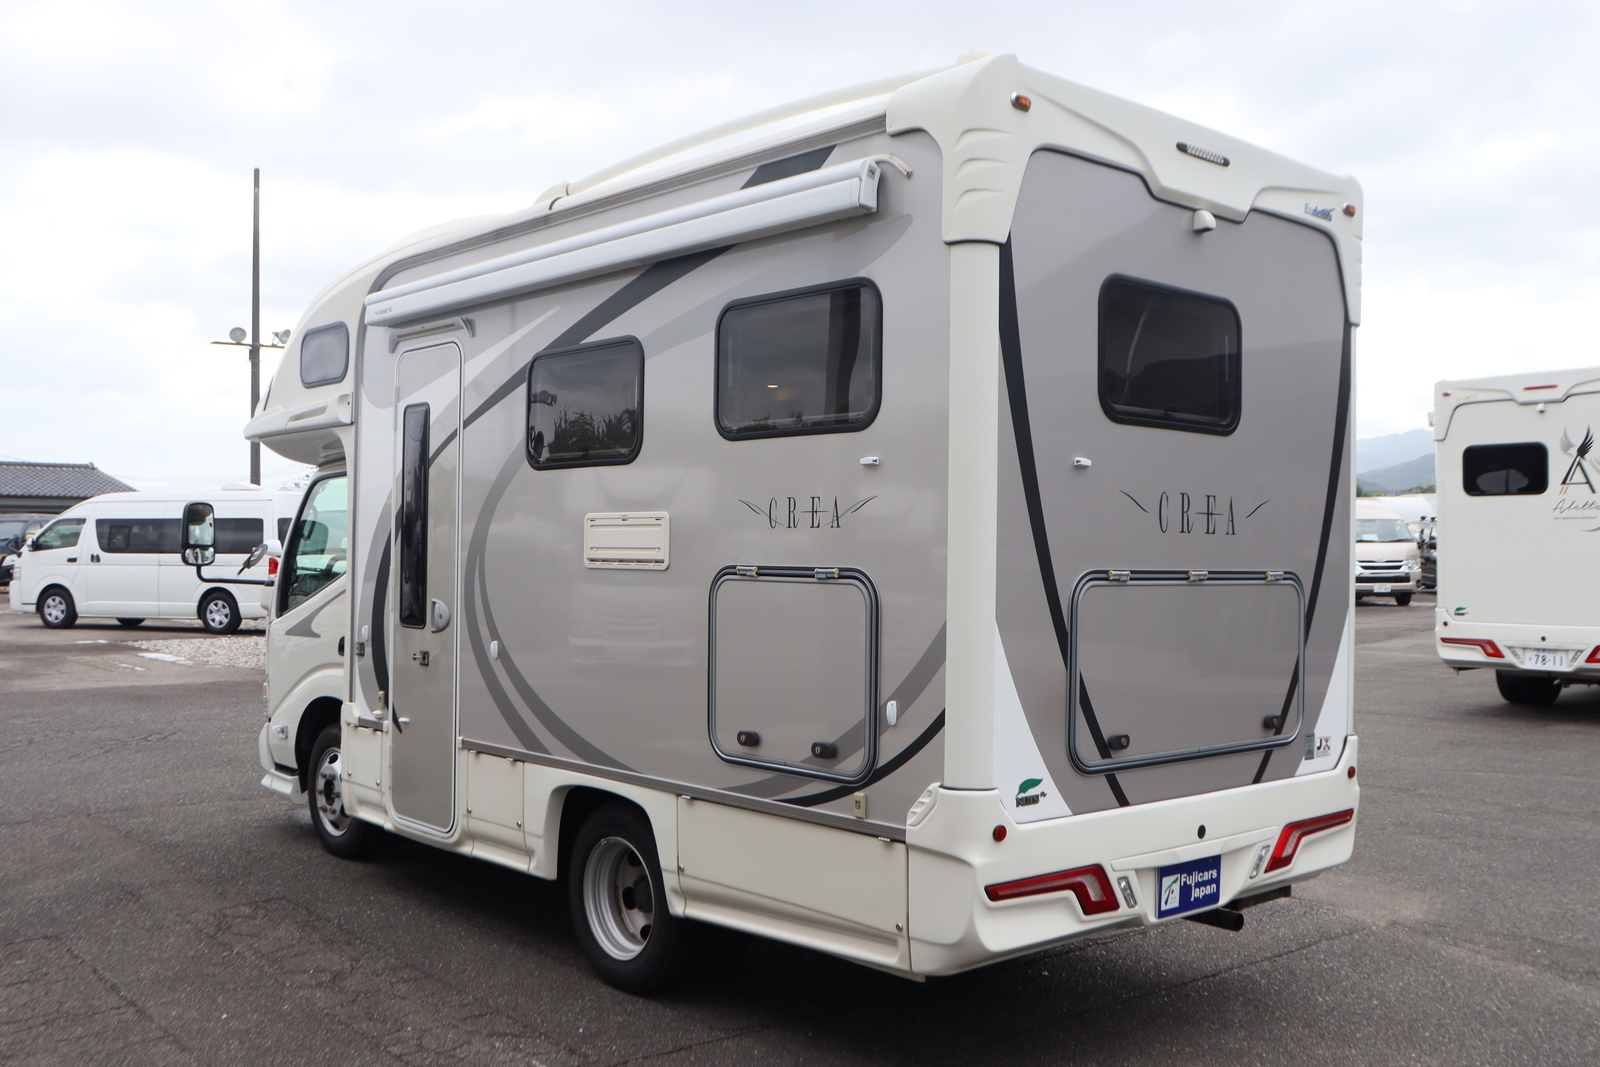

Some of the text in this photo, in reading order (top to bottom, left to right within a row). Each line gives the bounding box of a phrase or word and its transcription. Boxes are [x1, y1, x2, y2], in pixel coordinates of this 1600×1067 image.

[768, 496, 841, 529] CREA
[1158, 491, 1236, 535] CREA
[1181, 868, 1218, 887] Fujicars
